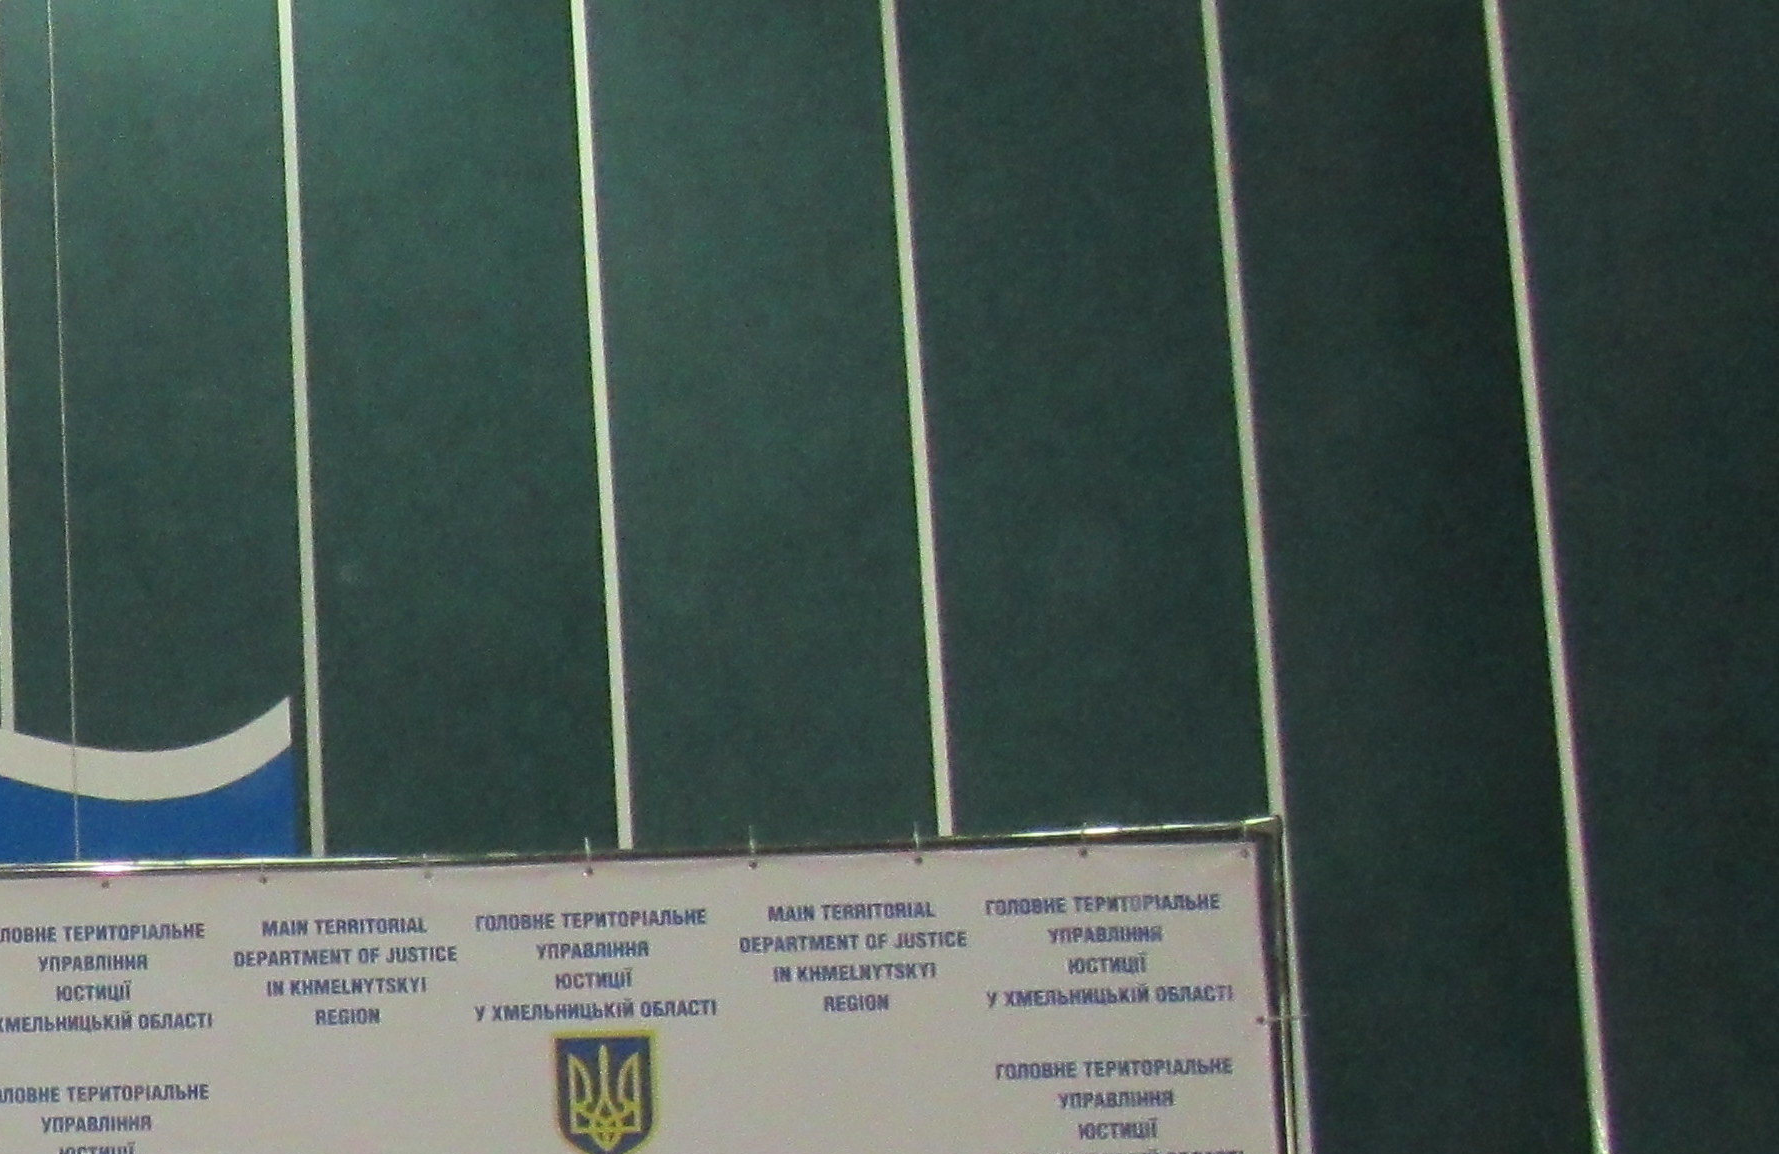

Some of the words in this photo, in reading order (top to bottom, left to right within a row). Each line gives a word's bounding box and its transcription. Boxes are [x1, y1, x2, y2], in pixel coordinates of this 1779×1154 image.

[767, 905, 815, 922] MAIN
[820, 902, 936, 921] TERRITORIAL
[984, 897, 1067, 916] ГОЛОВНЕ
[1072, 893, 1220, 912] ТЕРИТОРІАЛЬНЕ
[261, 920, 308, 936] MAIN
[313, 917, 427, 935] TERRITORIAL
[475, 913, 555, 932] ГОЛОВНЕ
[560, 908, 707, 928] ТЕРИТОРІАЛЬНЕ
[62, 923, 205, 942] ТЕРИТОРІАЛЬНЕ
[738, 934, 859, 953] DEPARTMENT
[865, 933, 887, 950] OF
[893, 930, 967, 949] JUSTICE
[1046, 925, 1163, 944] УПРАВЛІННЯ
[233, 948, 352, 968] DEPARTMENT
[357, 947, 380, 964] OF
[385, 946, 457, 963] JUSTICE
[535, 940, 650, 960] УПРАВЛІННЯ
[37, 953, 148, 972] УПРАВЛІННЯ
[773, 964, 792, 982] IN
[797, 962, 936, 982] KHMELNYTSKYI
[1067, 952, 1147, 975] ЮСТИЦІЇ
[266, 981, 284, 997] IN
[289, 977, 427, 996] KHMELNYTSKYI
[554, 967, 633, 990] ЮСТИЦІЇ
[55, 980, 131, 1002] ЮСТИЦІЇ
[986, 991, 998, 1008] У
[1004, 983, 1150, 1008] ХМЕЛЬНИЦЬКІЙ
[1155, 985, 1233, 1003] ОБЛАСТІ
[473, 1006, 485, 1022] У
[491, 998, 634, 1021] ХМЕЛЬНИЦЬКІЙ
[639, 999, 717, 1018] ОБЛАСТІ
[822, 994, 889, 1012] REGION
[137, 1012, 213, 1030] ОБЛАСТІ
[314, 1008, 381, 1026] REGION
[995, 1061, 1077, 1080] ГОЛОВНЕ
[1082, 1058, 1233, 1078] ТЕРИТОРІАЛЬНЕ
[65, 1083, 209, 1102] ТЕРИТОРІАЛЬНЕ
[1058, 1089, 1175, 1109] УПРАВЛІННЯ
[40, 1115, 152, 1134] УПРАВЛІННЯ
[1077, 1118, 1157, 1140] ЮСТИЦІЇ
